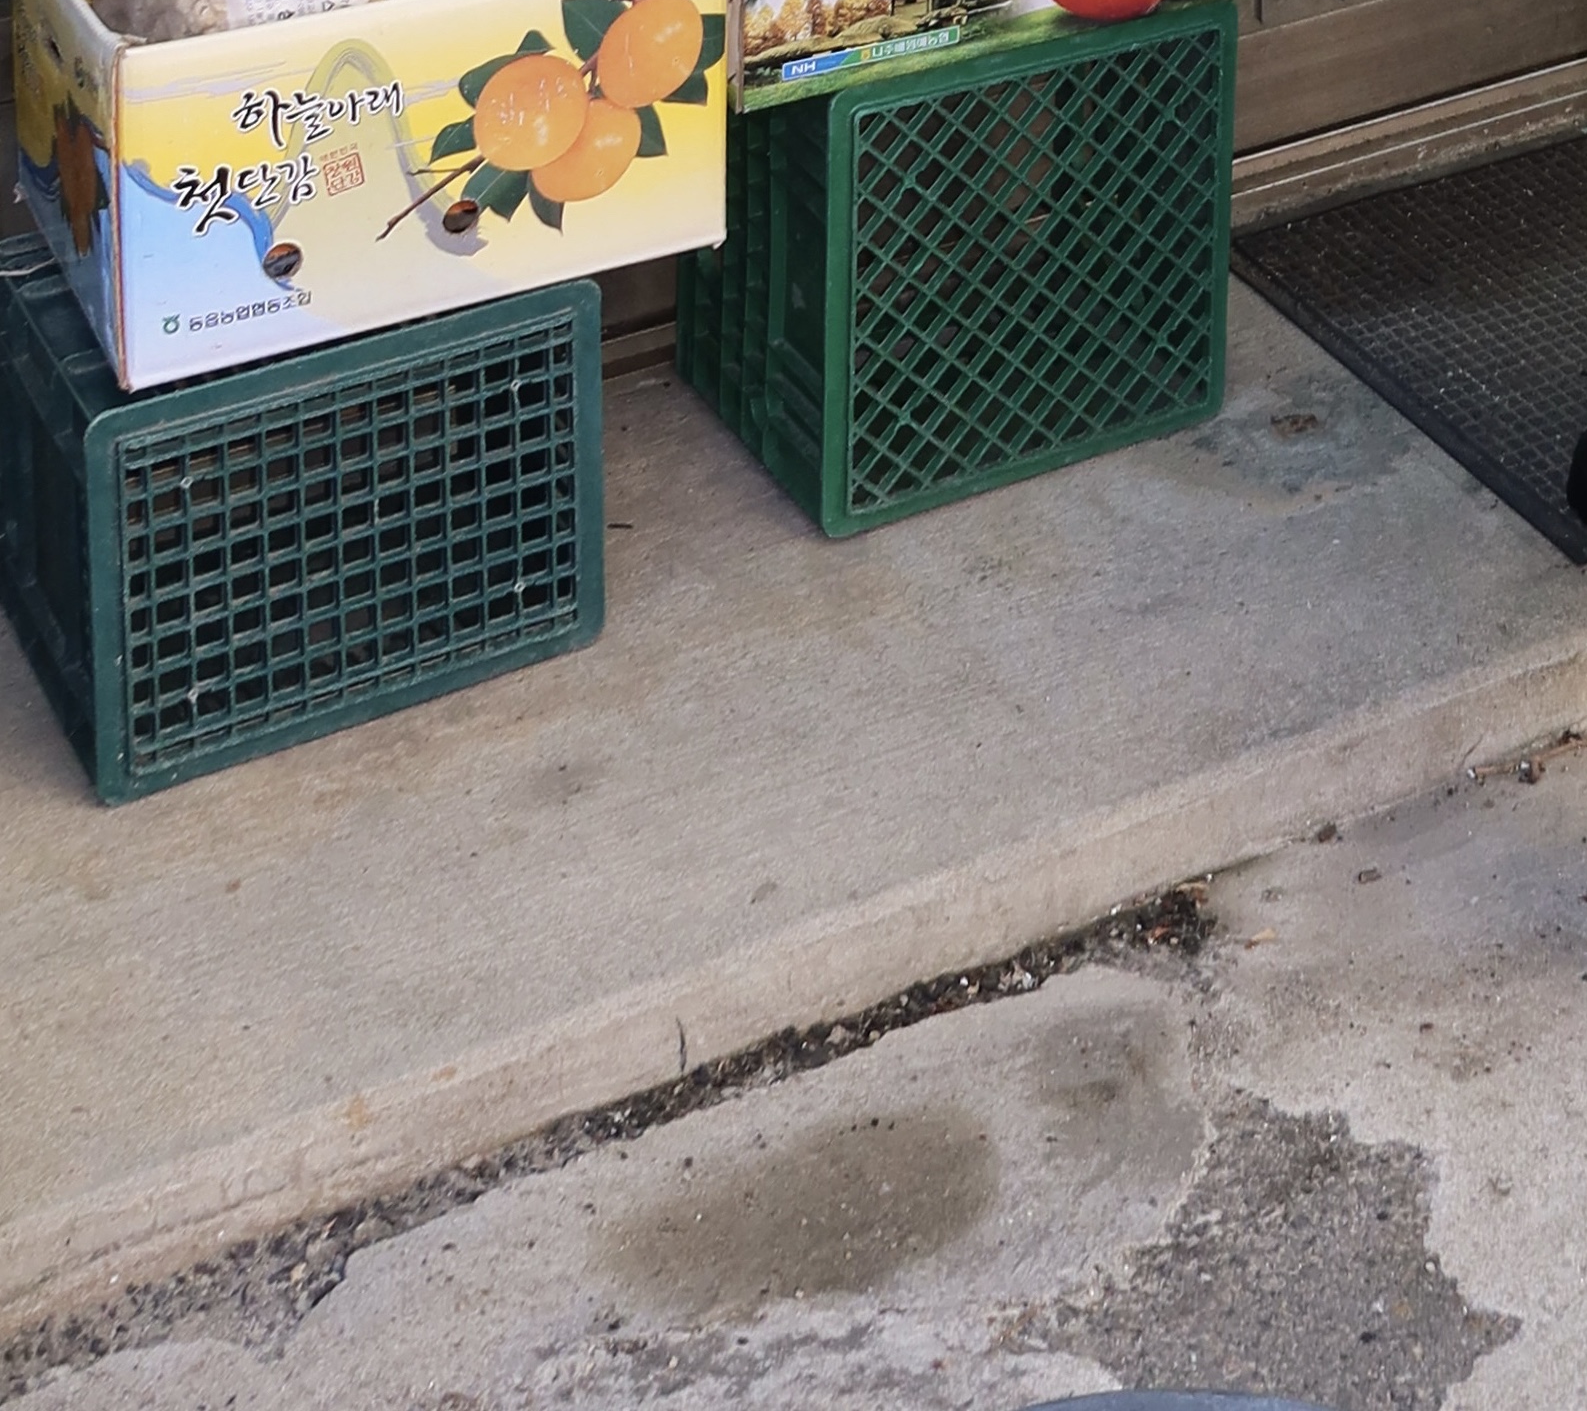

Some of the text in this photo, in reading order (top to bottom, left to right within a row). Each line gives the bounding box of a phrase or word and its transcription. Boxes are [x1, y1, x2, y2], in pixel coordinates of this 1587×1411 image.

[791, 60, 816, 76] NH
[232, 82, 403, 147] 하늘아래
[173, 155, 319, 233] 첫단감
